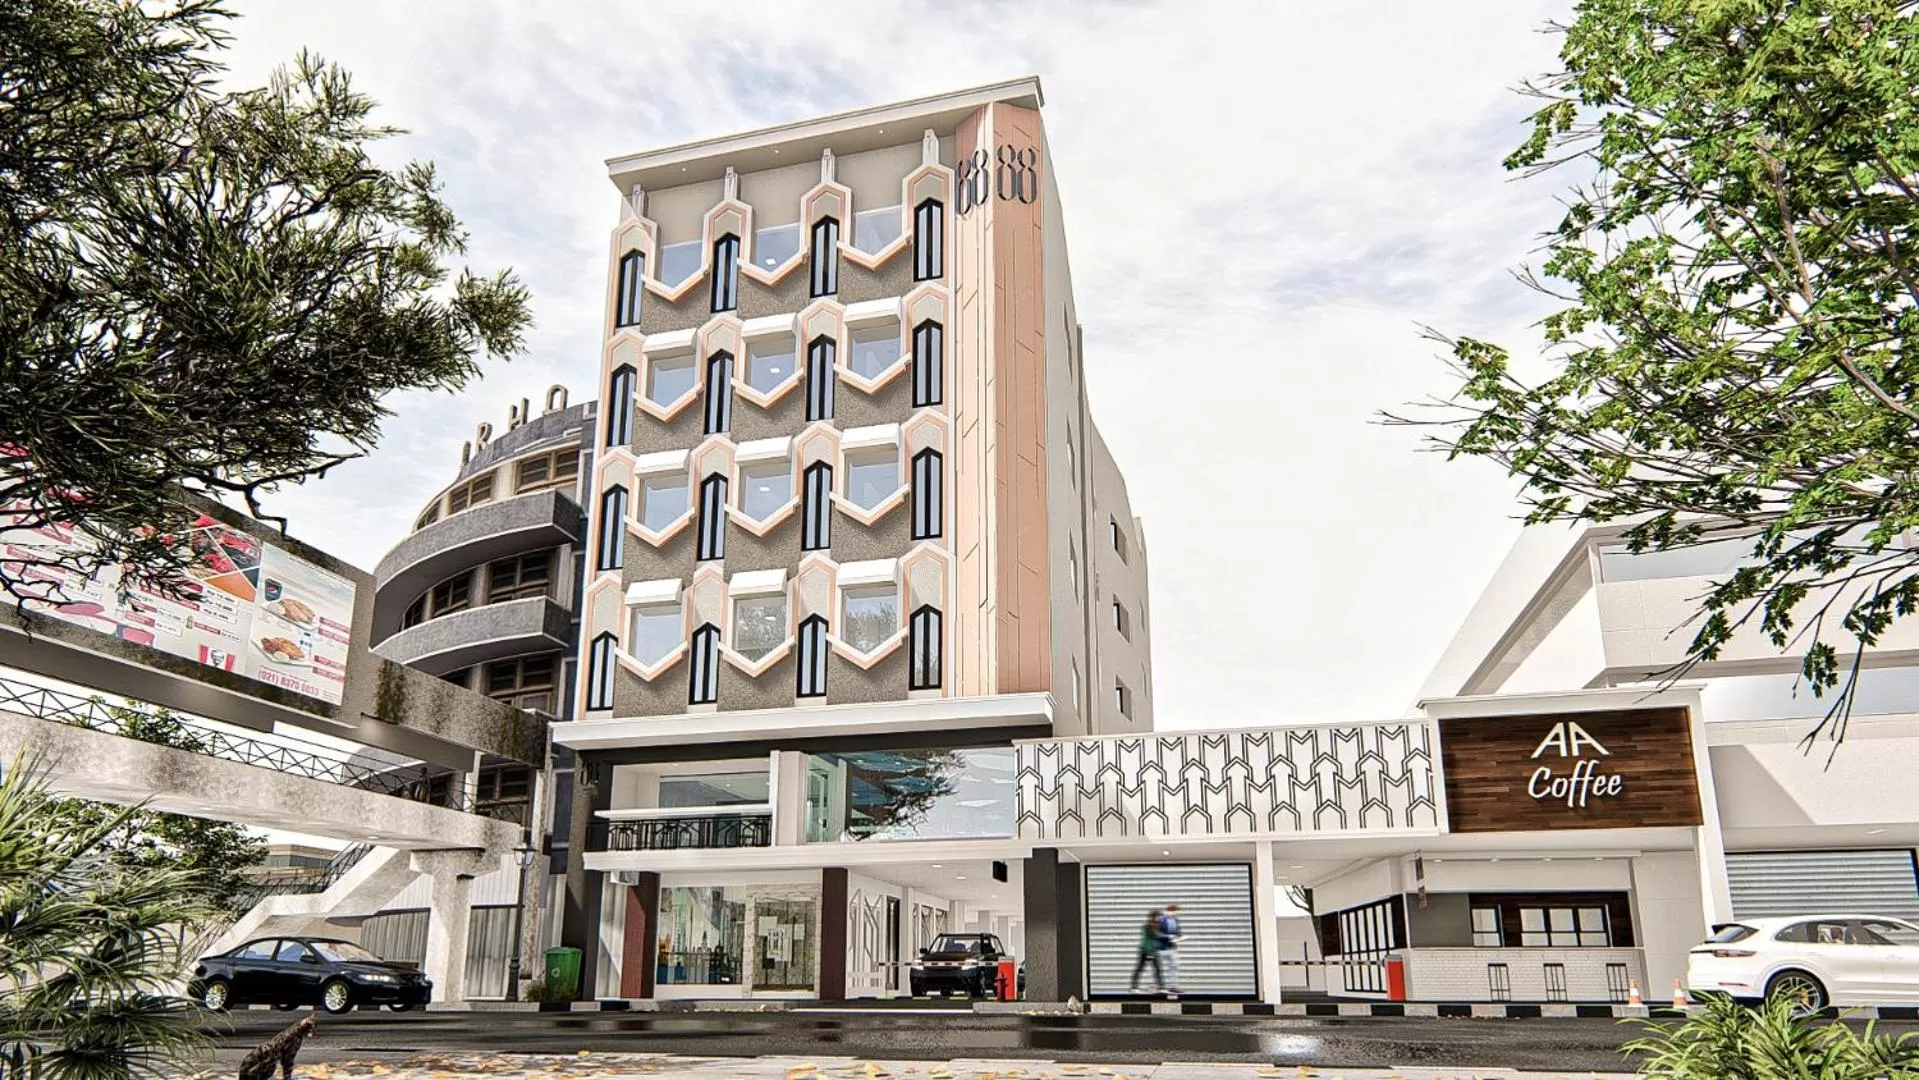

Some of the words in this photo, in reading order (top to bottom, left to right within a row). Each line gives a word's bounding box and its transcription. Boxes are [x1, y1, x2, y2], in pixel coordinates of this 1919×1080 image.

[997, 144, 1037, 204] 88
[257, 669, 280, 685] (021)
[1530, 721, 1610, 759] AA
[1527, 759, 1623, 809] Coffee
